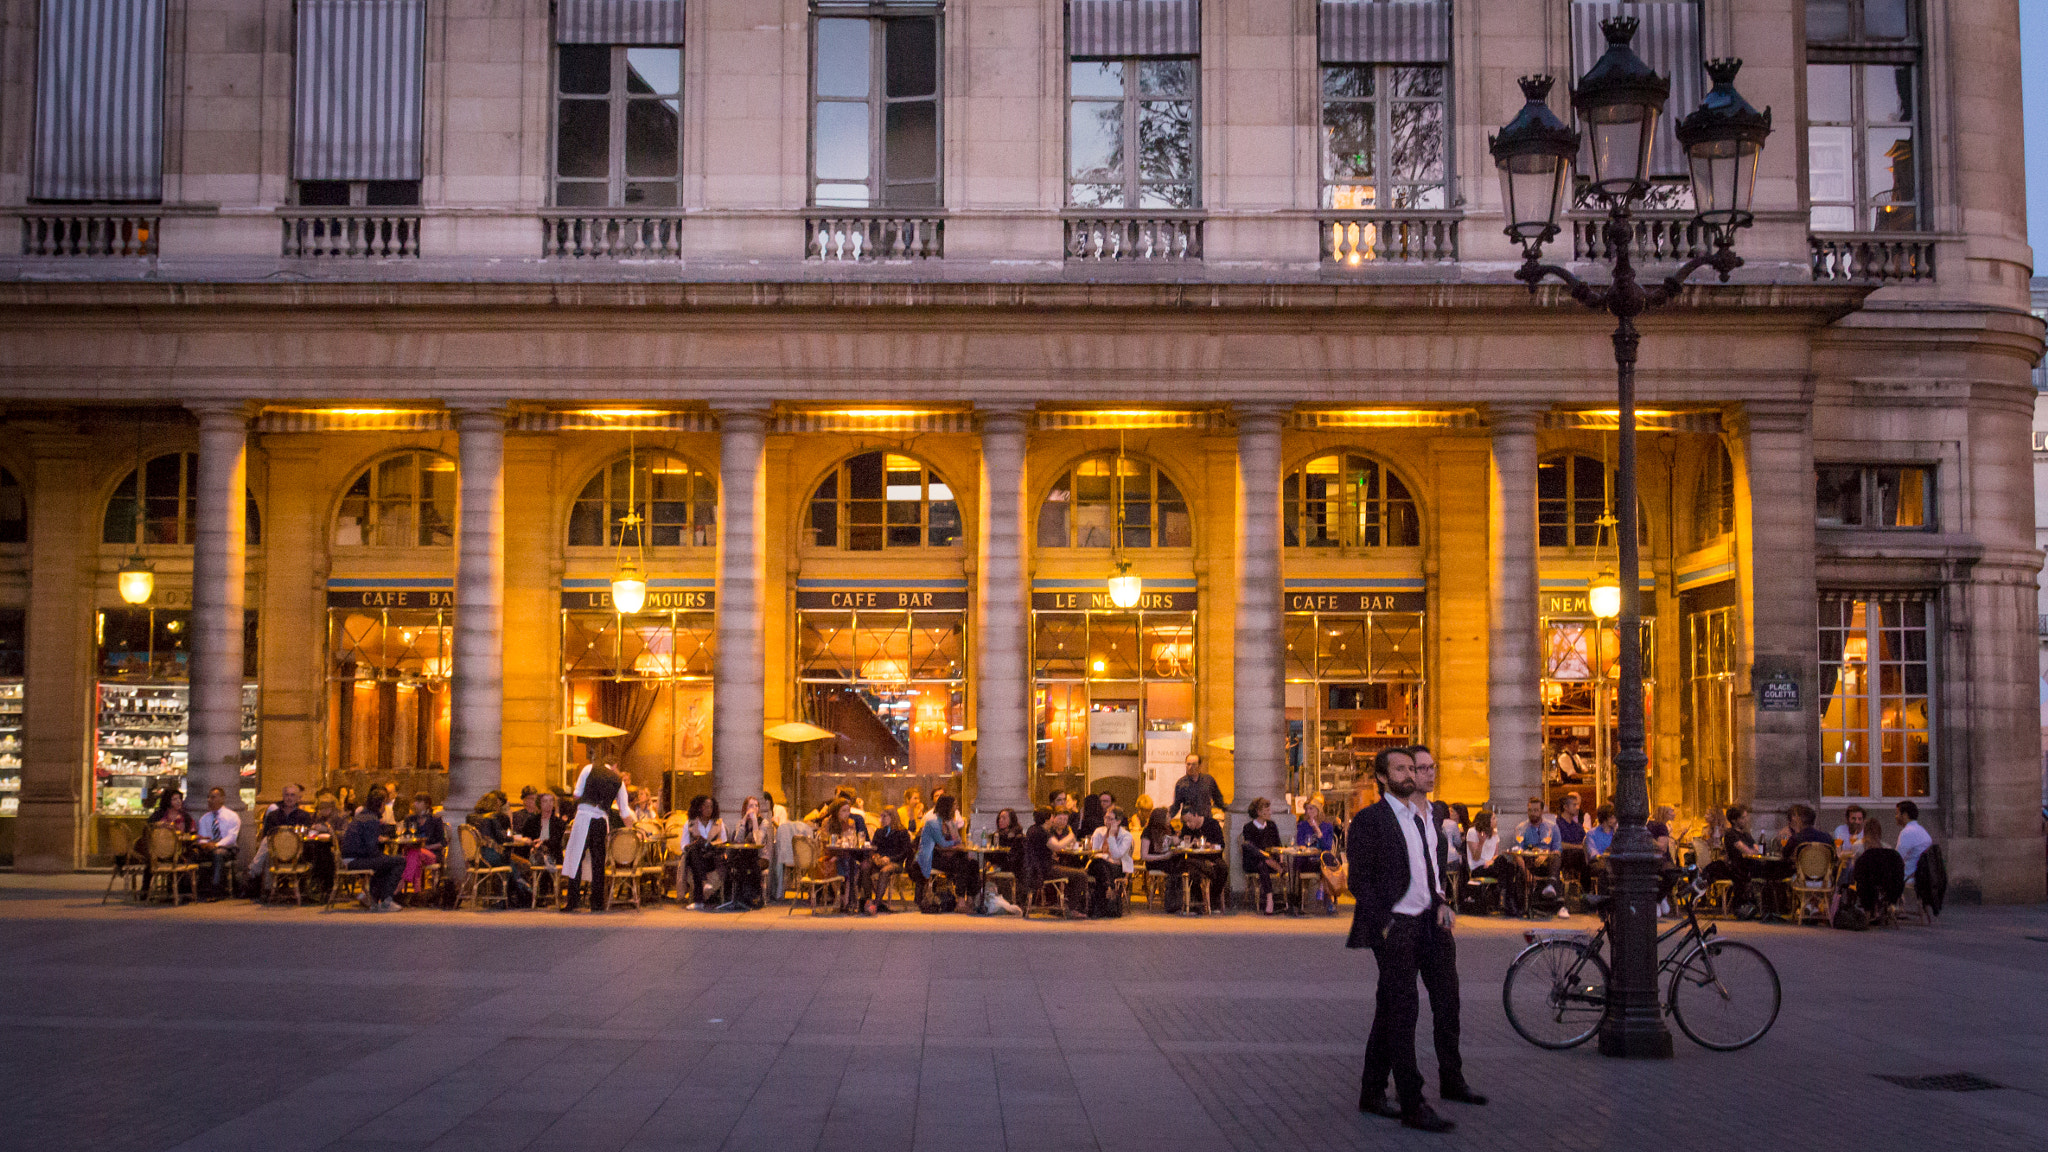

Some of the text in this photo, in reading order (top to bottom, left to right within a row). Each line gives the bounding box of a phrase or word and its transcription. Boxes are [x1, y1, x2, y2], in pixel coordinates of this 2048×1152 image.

[362, 592, 452, 605] CAFE BA
[589, 593, 706, 607] LE MOURS
[831, 593, 933, 607] CAFE BAR
[1056, 594, 1173, 608] LE NEURS
[1293, 596, 1395, 609] CAFE BAR
